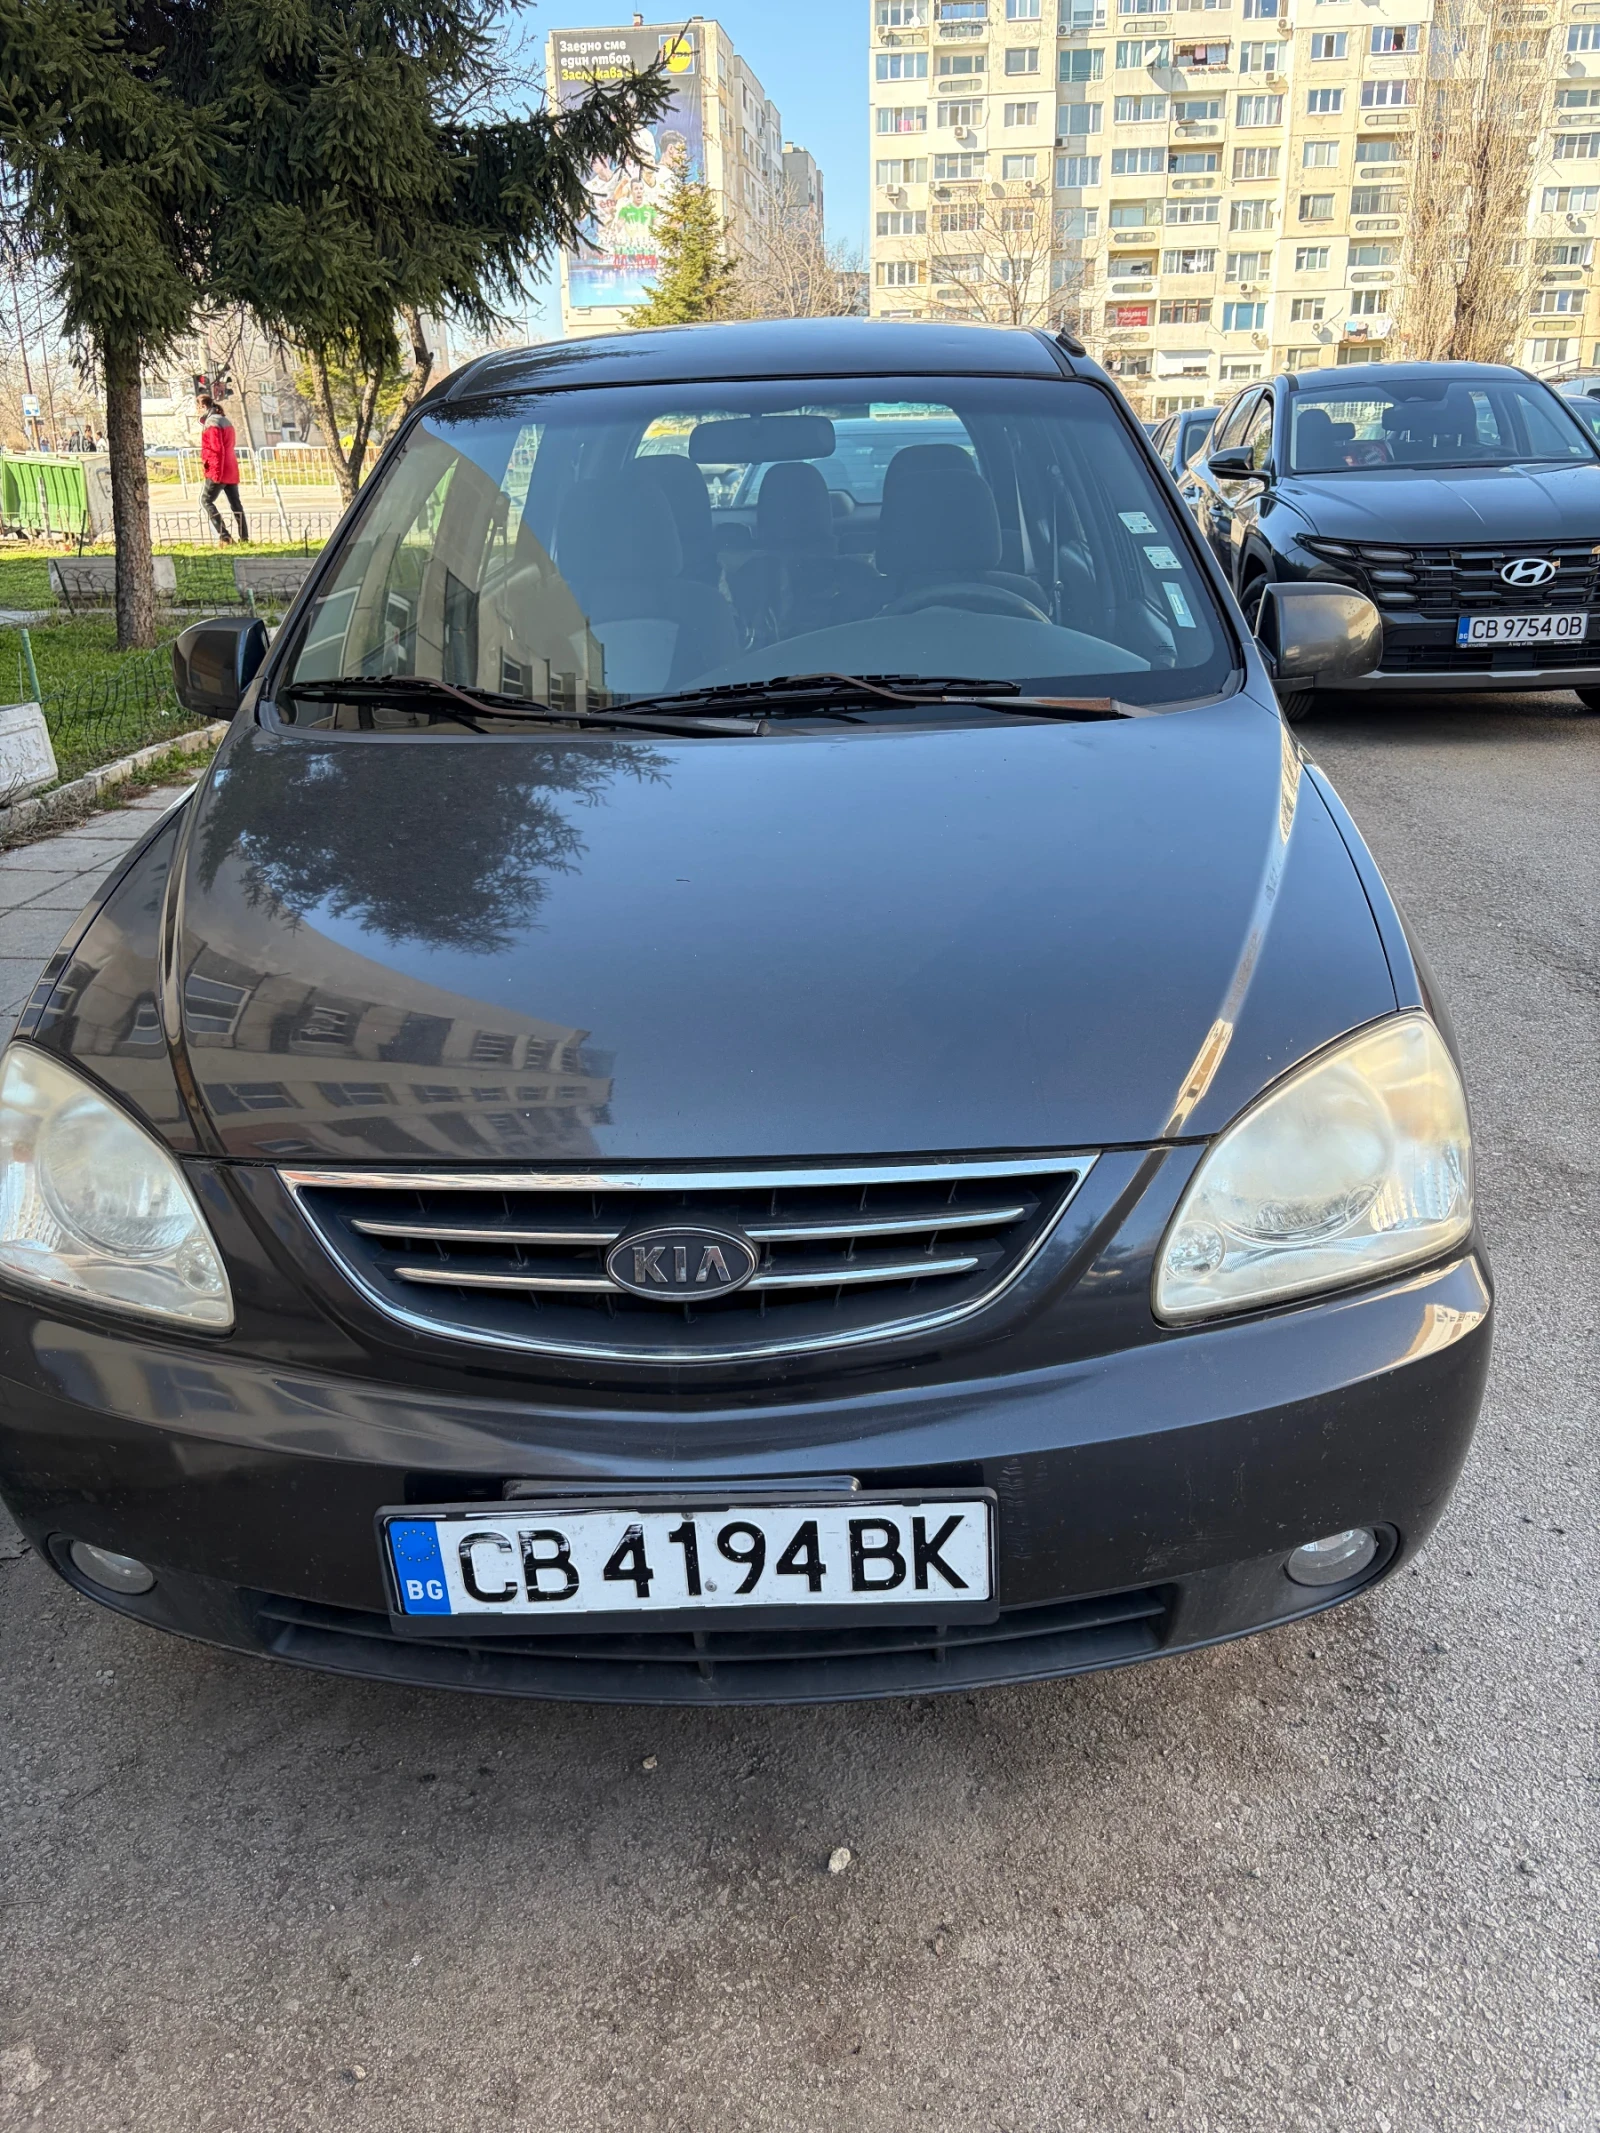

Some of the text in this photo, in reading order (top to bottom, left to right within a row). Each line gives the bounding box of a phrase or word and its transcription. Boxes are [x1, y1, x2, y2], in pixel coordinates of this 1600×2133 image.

[559, 40, 627, 54] Заедно сме
[560, 55, 589, 69] един
[1472, 620, 1498, 639] CB
[1503, 618, 1552, 638] 9754
[632, 1245, 732, 1283] KIA
[457, 1514, 970, 1602] CB 4194 BK
[406, 1579, 443, 1601] BG
